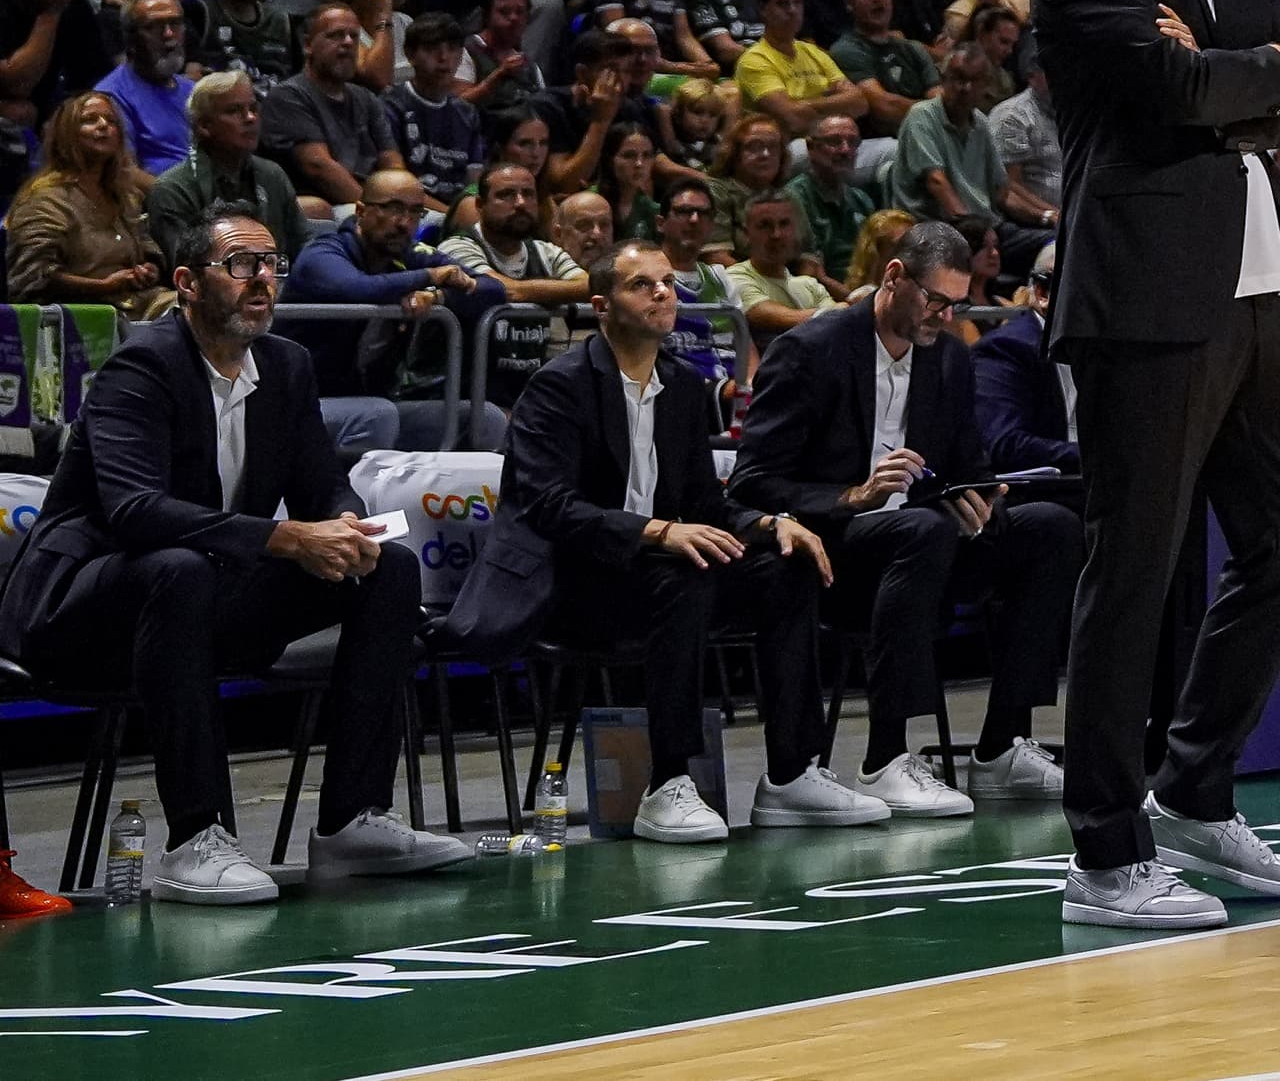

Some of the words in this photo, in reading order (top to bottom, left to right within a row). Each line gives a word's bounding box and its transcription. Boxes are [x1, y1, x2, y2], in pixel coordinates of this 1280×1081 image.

[422, 484, 498, 522] cost
[422, 530, 477, 570] del
[0, 933, 710, 1036] YRE
